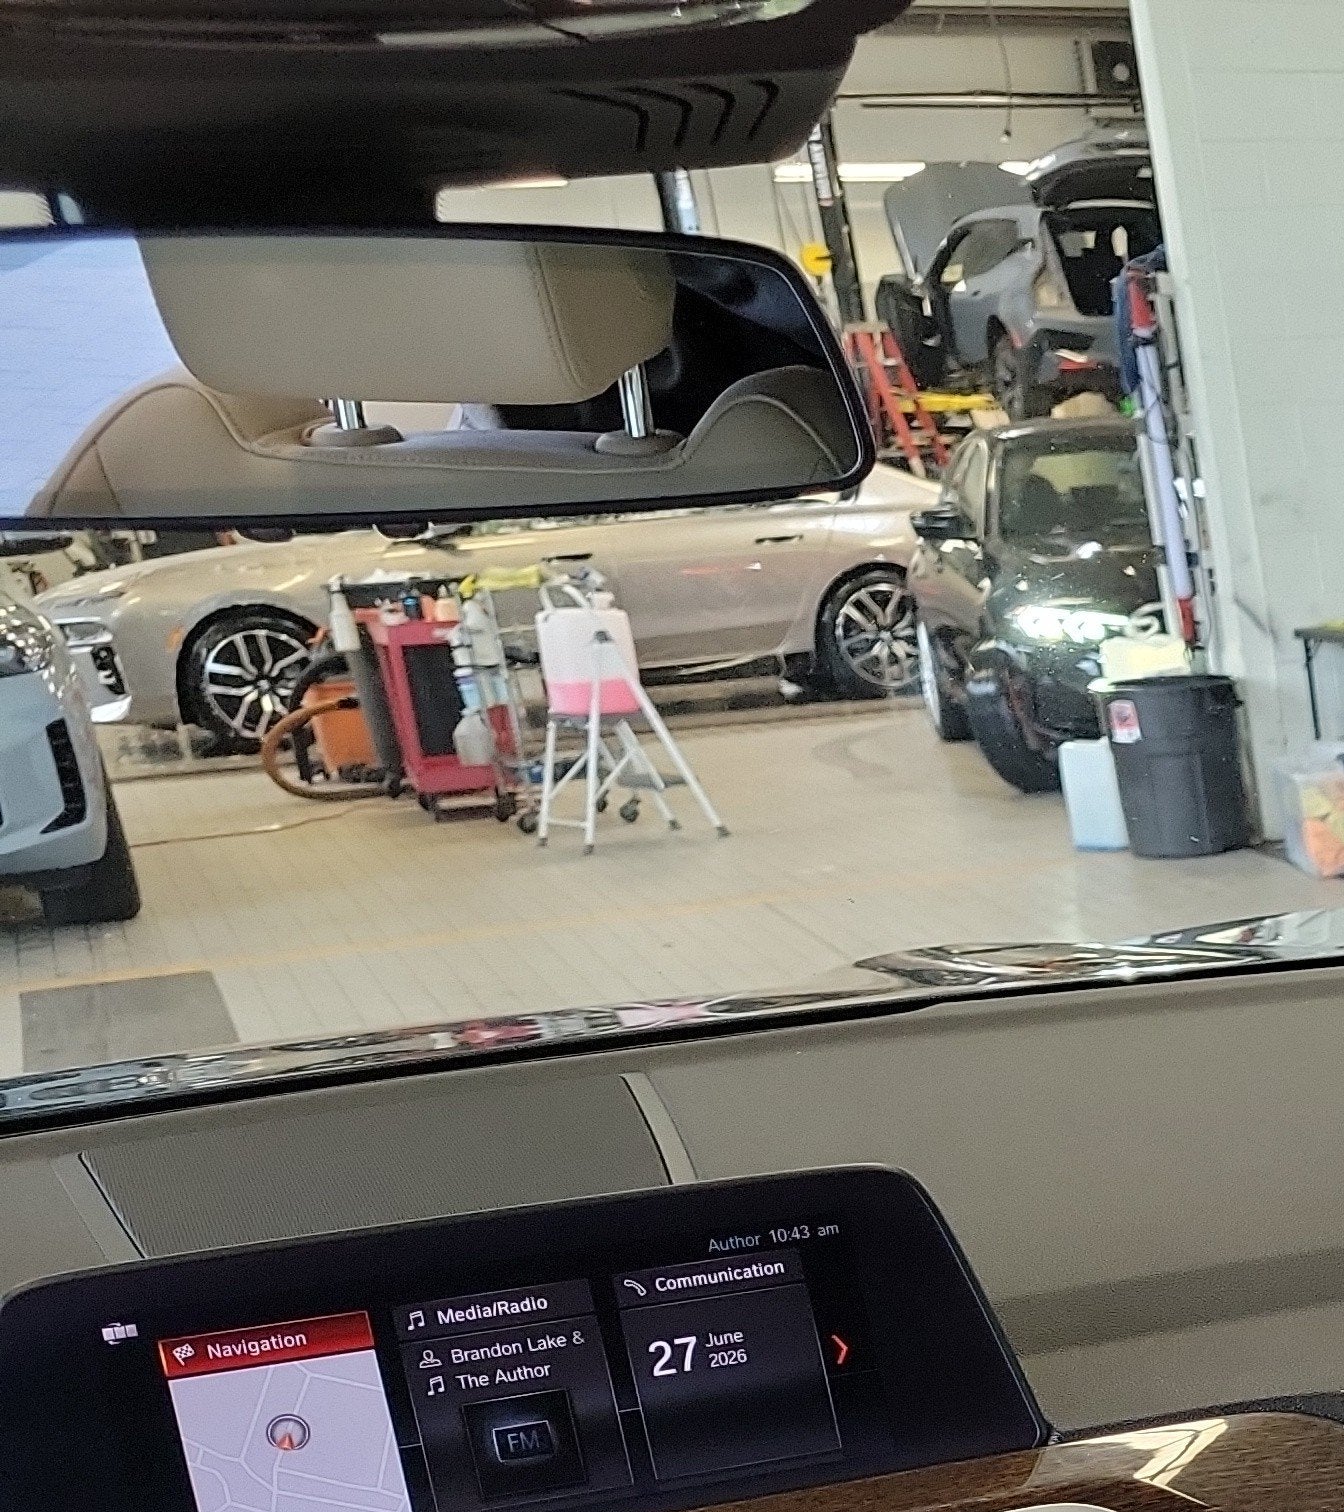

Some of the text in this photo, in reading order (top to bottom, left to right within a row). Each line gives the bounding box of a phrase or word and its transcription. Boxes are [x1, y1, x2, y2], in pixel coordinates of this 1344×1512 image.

[708, 1223, 840, 1253] Author 10:43 am
[655, 1261, 785, 1292] Communication
[436, 1296, 548, 1325] Media/Radio
[205, 1332, 308, 1361] Navigation
[450, 1330, 586, 1365] Brandon Lake &
[704, 1330, 745, 1348] June
[648, 1335, 698, 1377] 27
[708, 1348, 748, 1368] 2026
[454, 1363, 552, 1390] The Author
[506, 1429, 541, 1454] FM
